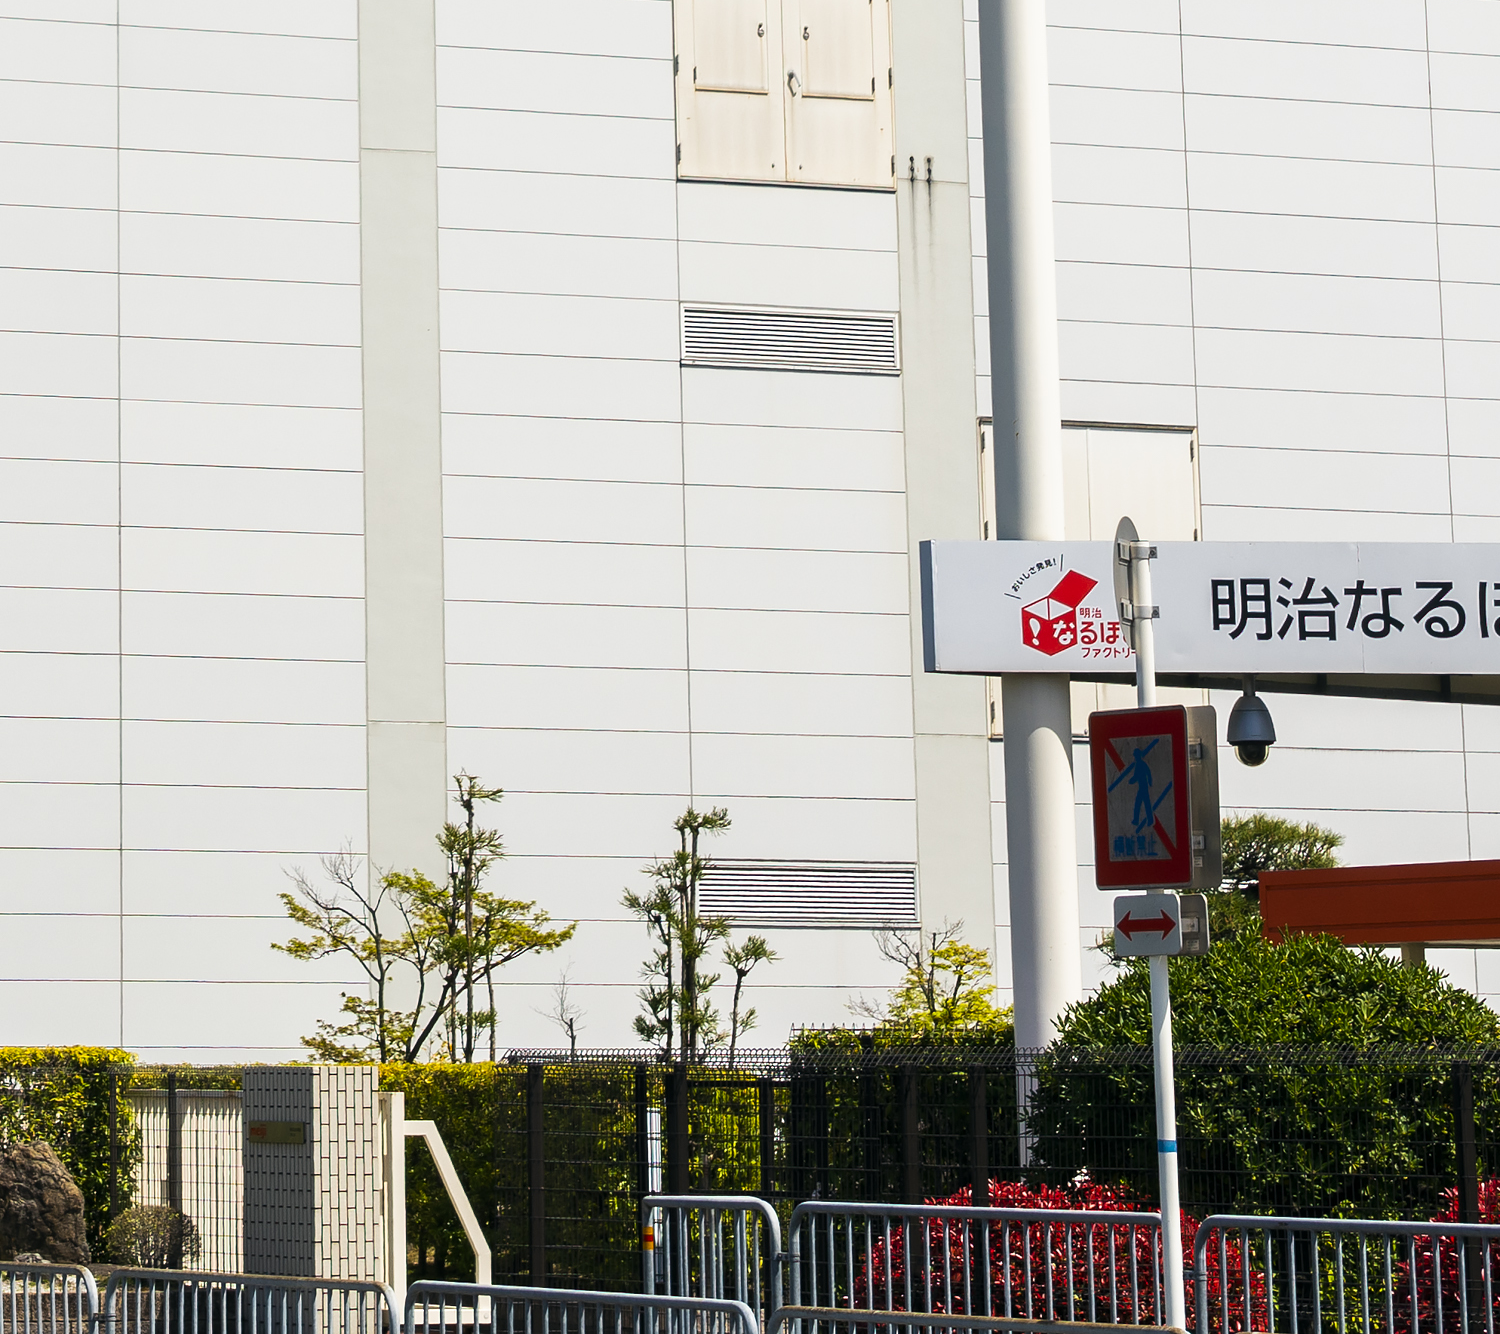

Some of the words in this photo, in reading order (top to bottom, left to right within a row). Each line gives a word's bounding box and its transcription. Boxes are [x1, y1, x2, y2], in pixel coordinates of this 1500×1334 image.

[1079, 607, 1102, 619] 明治
[1052, 620, 1128, 646] なるほ
